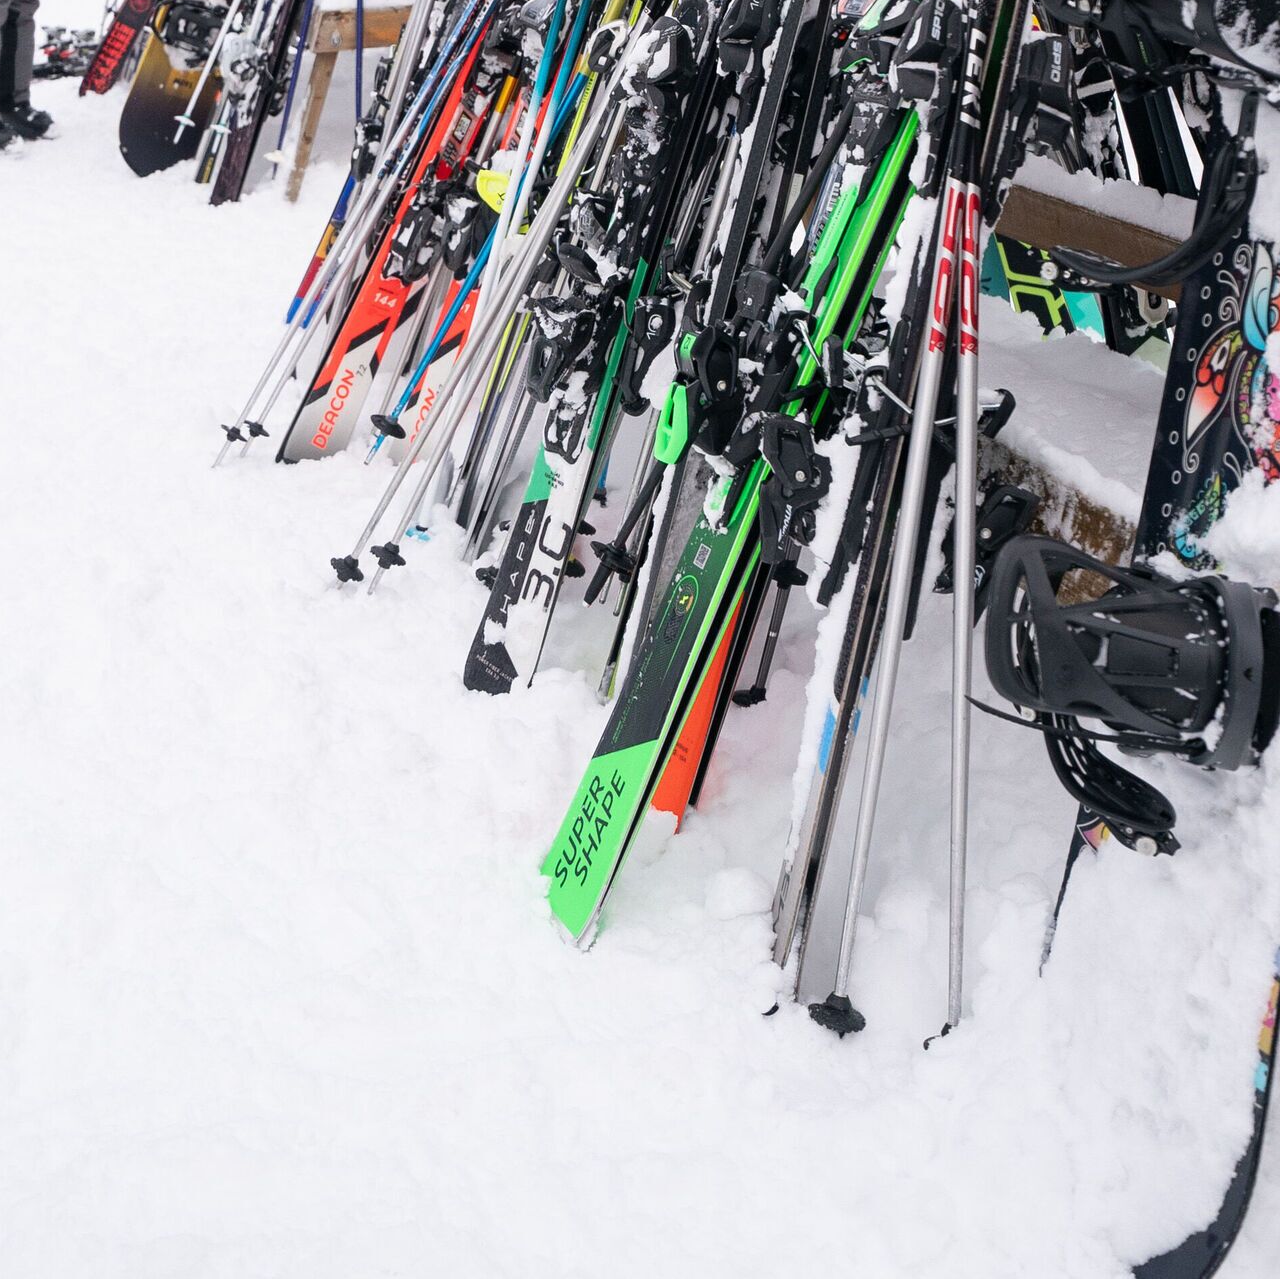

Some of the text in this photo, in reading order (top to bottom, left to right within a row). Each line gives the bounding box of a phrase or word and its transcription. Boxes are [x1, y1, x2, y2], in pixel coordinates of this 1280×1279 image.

[960, 27, 987, 130] LEKI
[374, 292, 398, 308] 144
[312, 368, 357, 450] DEACON
[554, 776, 605, 888] SUPER
[574, 769, 626, 887] SHAPE
